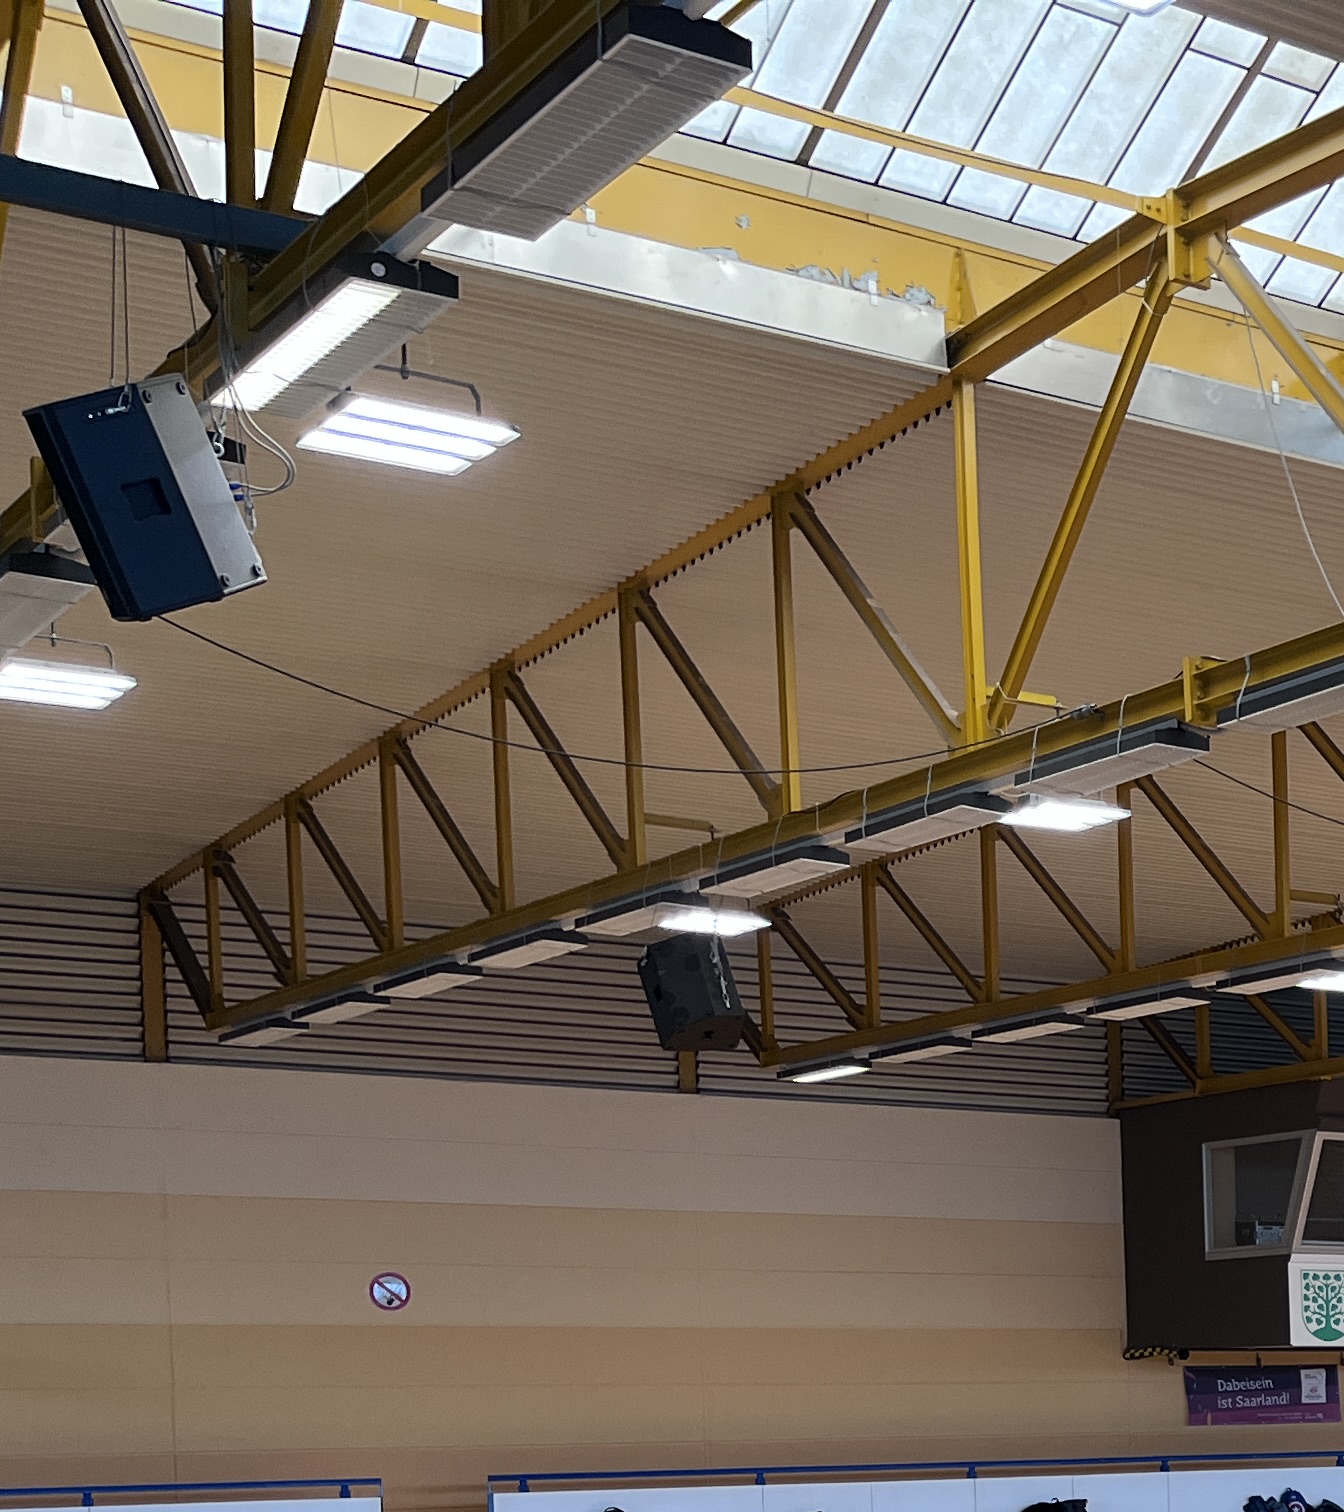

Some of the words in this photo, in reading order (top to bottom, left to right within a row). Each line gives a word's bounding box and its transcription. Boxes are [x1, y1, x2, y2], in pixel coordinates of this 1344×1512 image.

[1216, 1377, 1274, 1392] Dabeisein
[1217, 1395, 1233, 1409] ist
[1235, 1391, 1290, 1408] Saarland!
